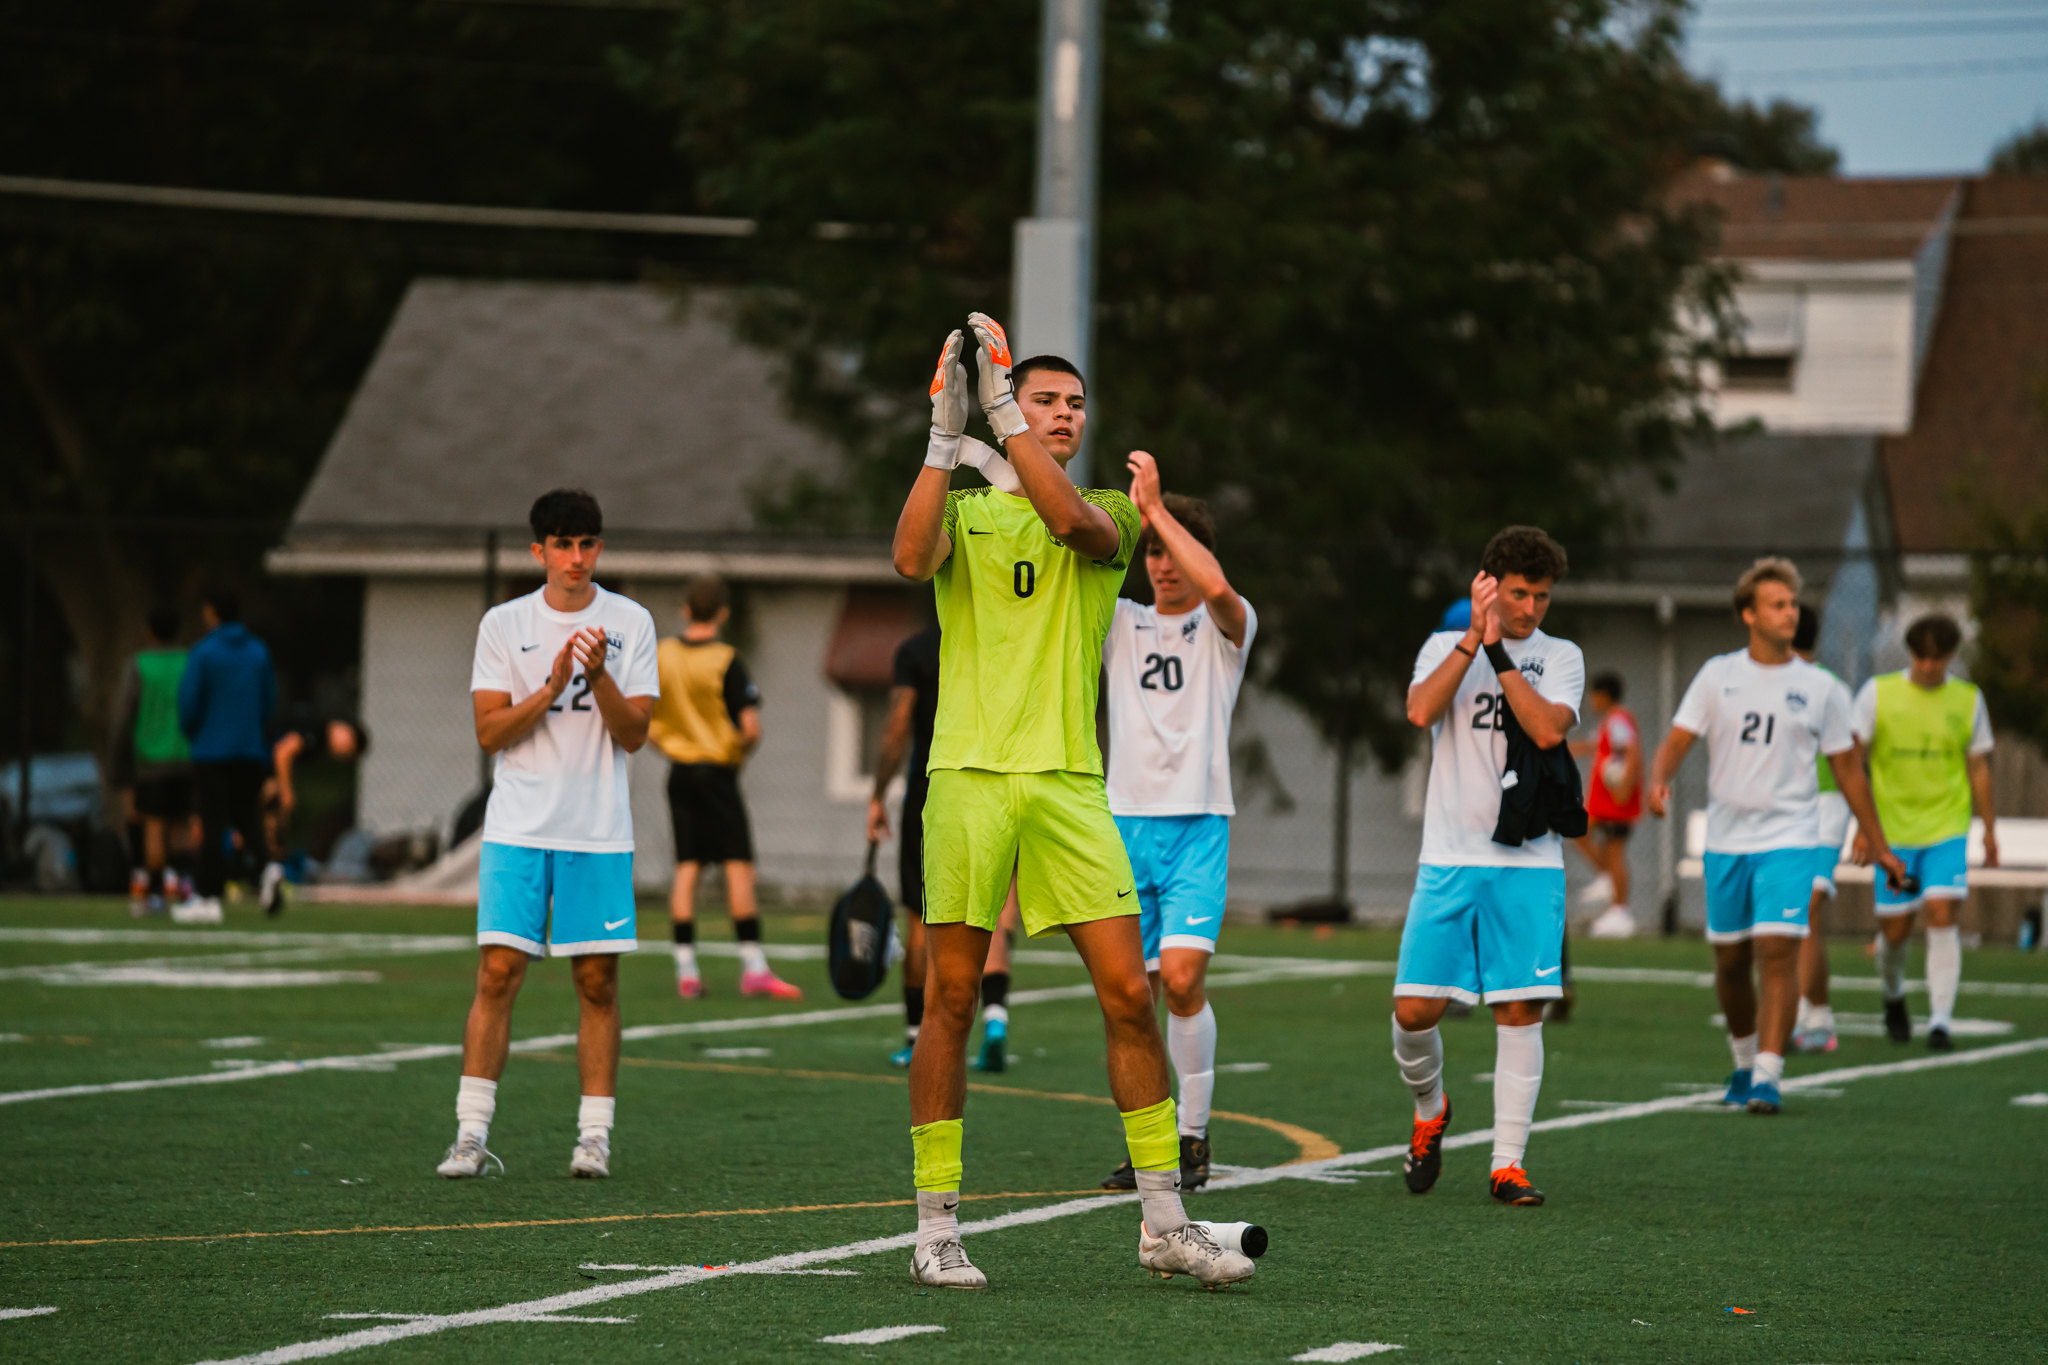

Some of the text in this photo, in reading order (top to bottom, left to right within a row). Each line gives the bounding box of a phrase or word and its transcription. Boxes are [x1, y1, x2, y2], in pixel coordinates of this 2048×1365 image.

[1013, 560, 1035, 598] 0
[1141, 653, 1184, 692] 20
[545, 673, 592, 712] 2
[1741, 711, 1775, 745] 21
